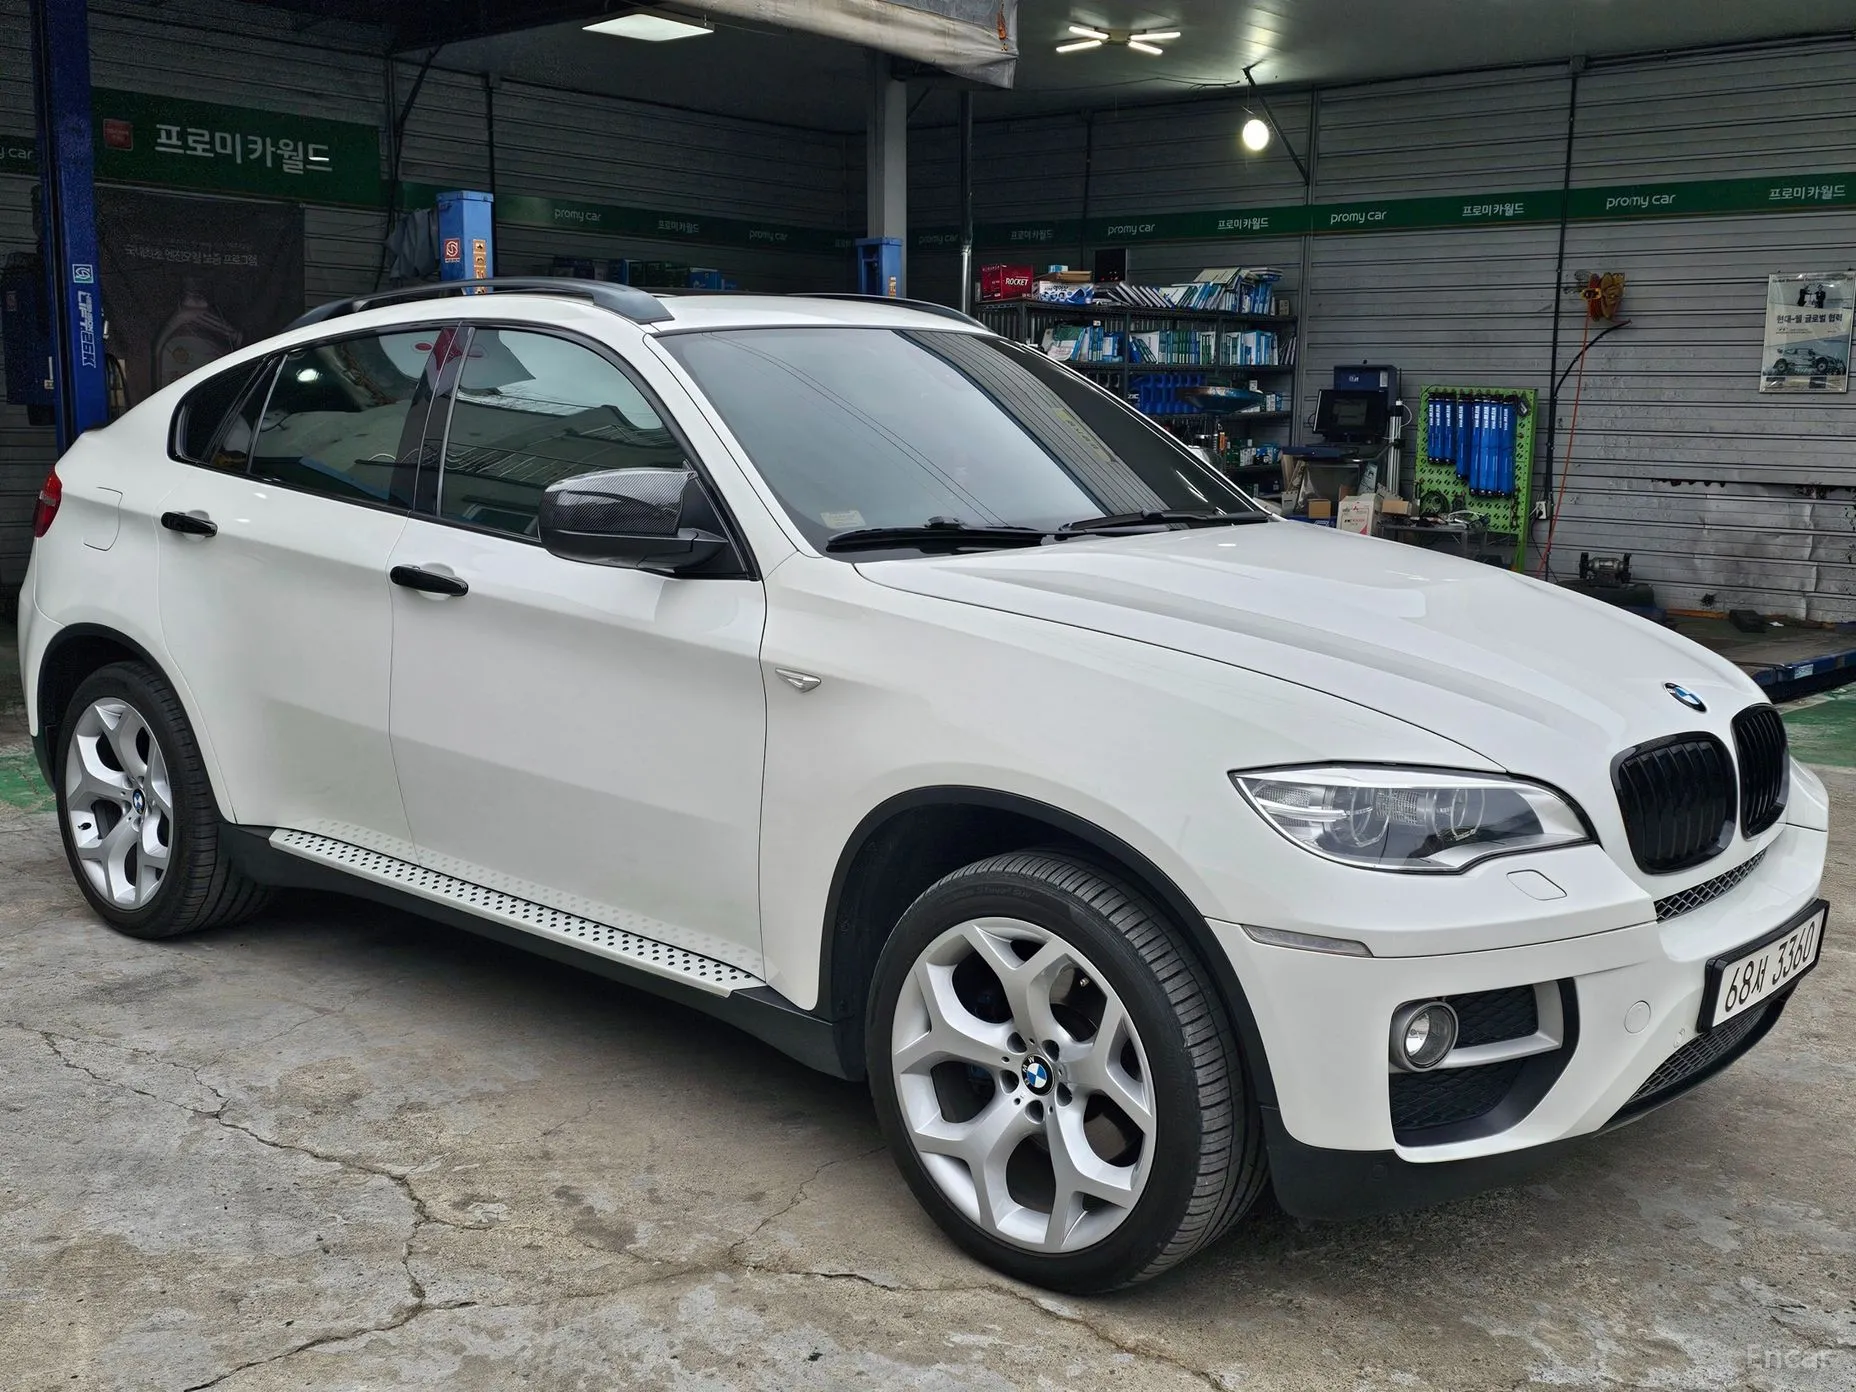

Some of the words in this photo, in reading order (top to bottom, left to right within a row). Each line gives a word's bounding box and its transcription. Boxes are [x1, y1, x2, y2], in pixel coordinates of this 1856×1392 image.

[8, 147, 34, 160] car
[154, 123, 333, 175] 프로미카월드
[1768, 184, 1847, 200] 프로미카월드
[1605, 196, 1650, 210] promy
[1651, 193, 1677, 205] car
[554, 208, 584, 222] promy
[585, 211, 603, 222] car
[1461, 202, 1525, 217] 프로미카월드
[1216, 216, 1270, 230] 프로미카월드
[1330, 211, 1365, 225] promy
[1367, 210, 1388, 222] car
[657, 219, 700, 234] 프로미카월드
[1107, 223, 1137, 236] promy
[1138, 222, 1156, 233] car
[749, 229, 774, 242] promy
[774, 231, 789, 241] car
[1005, 277, 1029, 286] ROCKET
[1772, 921, 1815, 986] 3360
